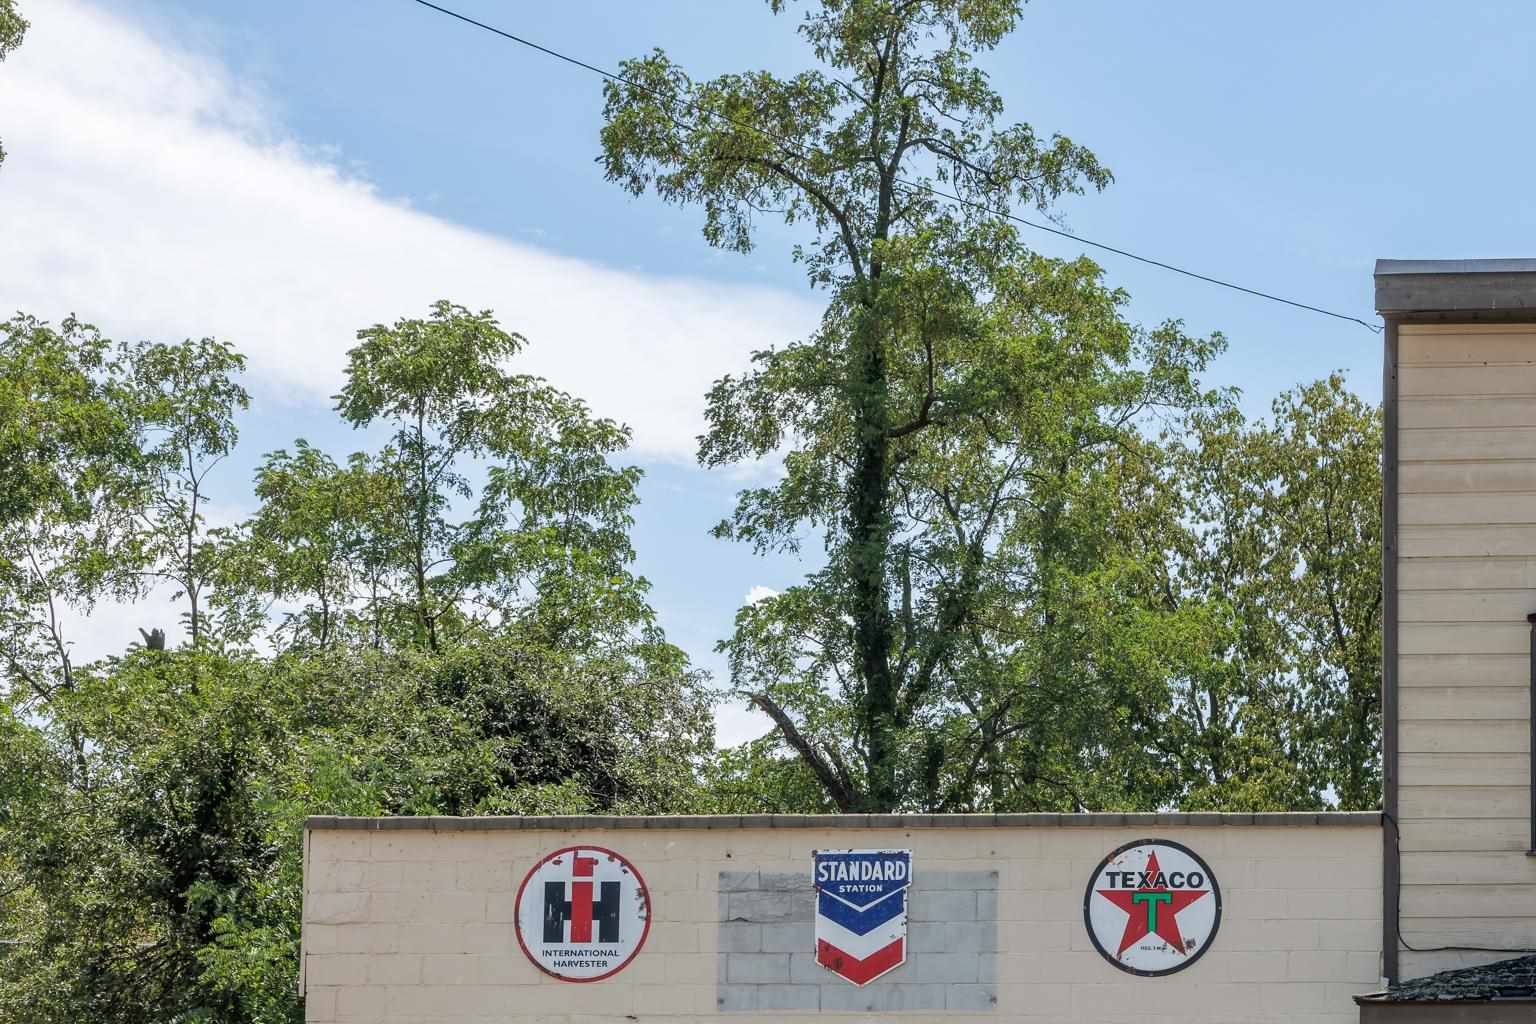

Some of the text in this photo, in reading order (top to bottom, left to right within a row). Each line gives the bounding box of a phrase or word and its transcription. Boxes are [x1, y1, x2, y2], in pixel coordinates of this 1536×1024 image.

[818, 860, 907, 882] STANDARD
[1105, 871, 1204, 889] TEXACO
[839, 884, 883, 893] STATION
[542, 949, 620, 957] INTERNATIONAL
[553, 960, 608, 968] HARVESTER
